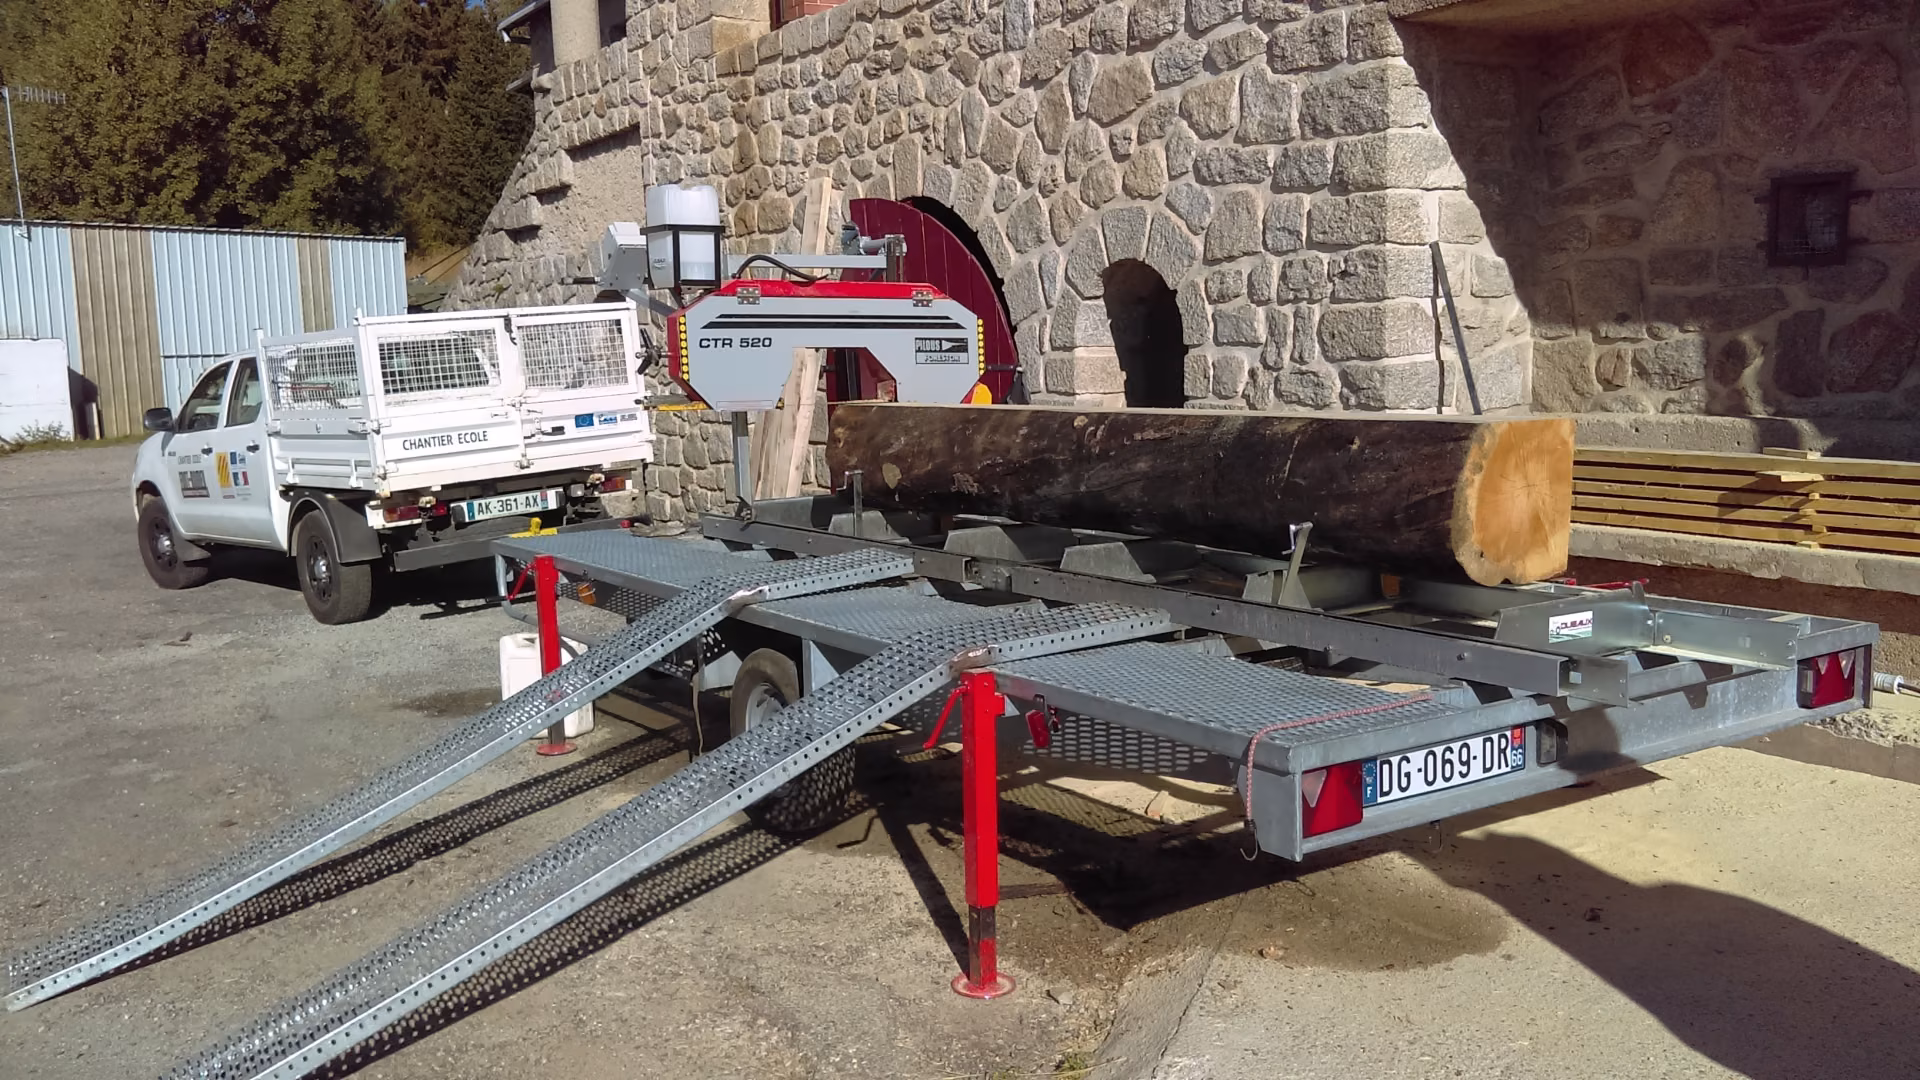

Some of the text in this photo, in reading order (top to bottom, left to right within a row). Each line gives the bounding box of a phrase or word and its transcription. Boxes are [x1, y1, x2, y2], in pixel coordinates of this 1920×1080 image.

[699, 336, 773, 348] CTR 520
[915, 339, 941, 352] PILOUS
[402, 430, 489, 450] CHANTIER ECOLE
[477, 494, 539, 515] AK-361-AX
[1366, 733, 1523, 798] F DG-069-DR 66
